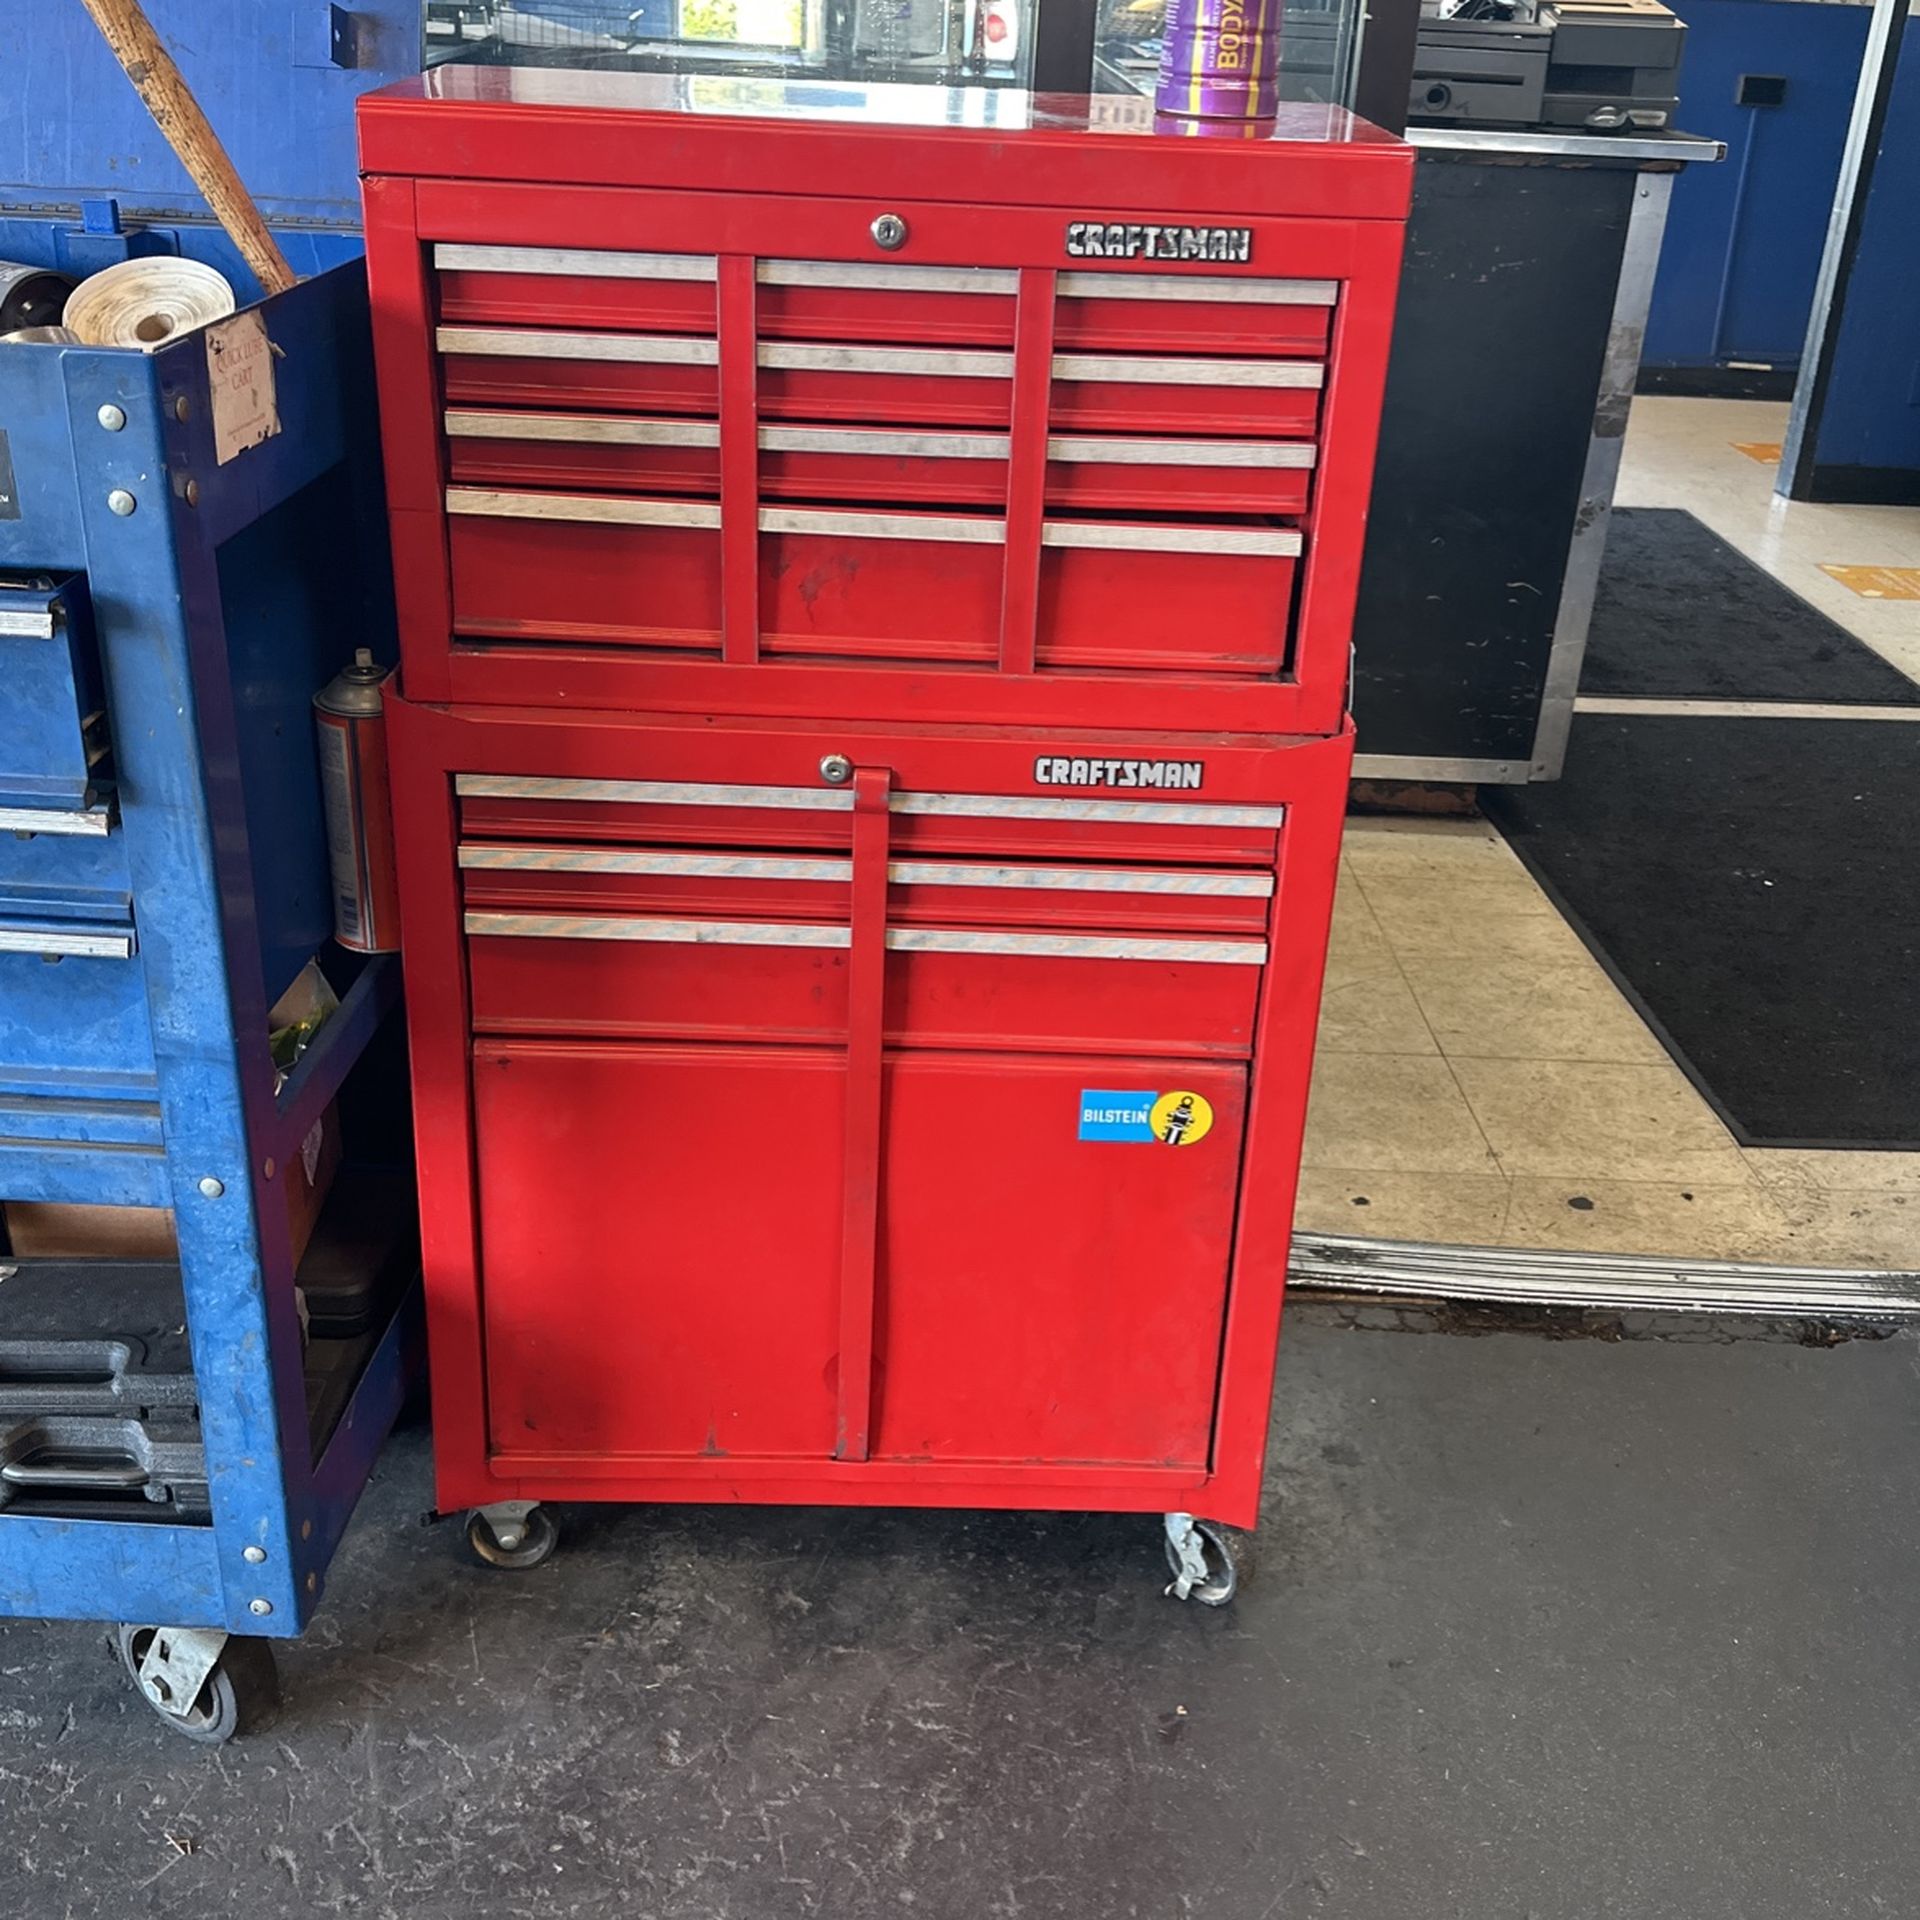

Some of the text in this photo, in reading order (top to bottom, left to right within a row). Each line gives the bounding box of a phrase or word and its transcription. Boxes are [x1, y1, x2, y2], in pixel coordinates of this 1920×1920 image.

[1217, 0, 1244, 68] BODY
[1068, 223, 1252, 262] CRAFTSMAN
[231, 366, 253, 391] CART
[1035, 757, 1203, 789] CRAFTSMAN
[1083, 1108, 1148, 1123] BILSTEIN
